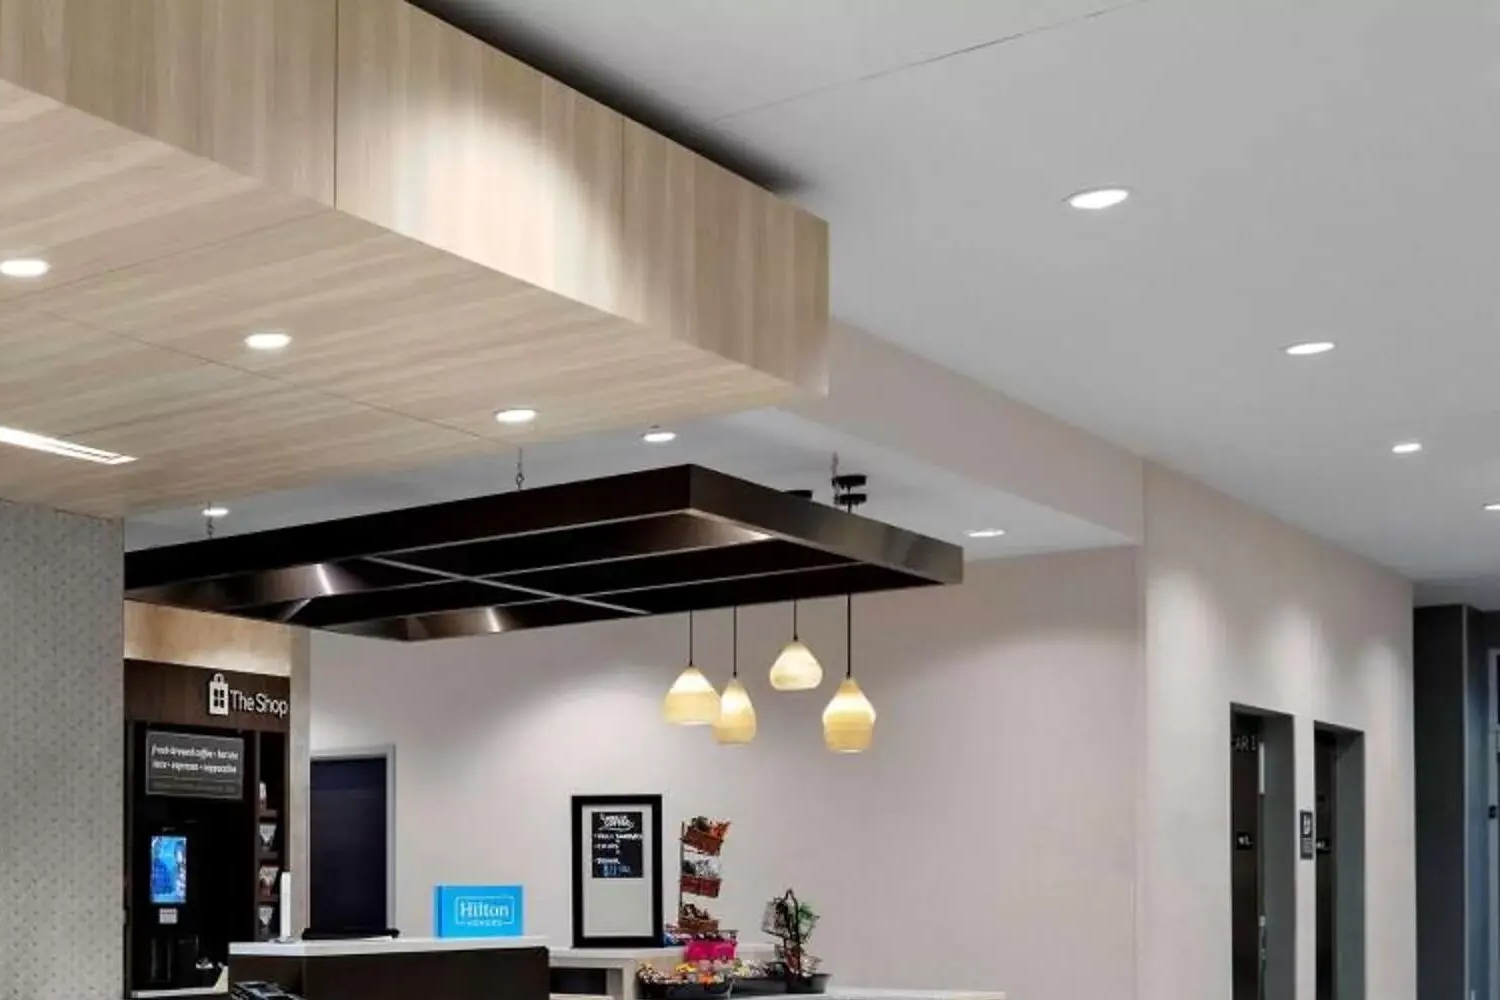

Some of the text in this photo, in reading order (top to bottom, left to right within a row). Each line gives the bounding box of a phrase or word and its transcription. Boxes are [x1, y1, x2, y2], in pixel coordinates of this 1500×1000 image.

[229, 689, 289, 718] The Shop
[459, 901, 510, 917] Hilton
